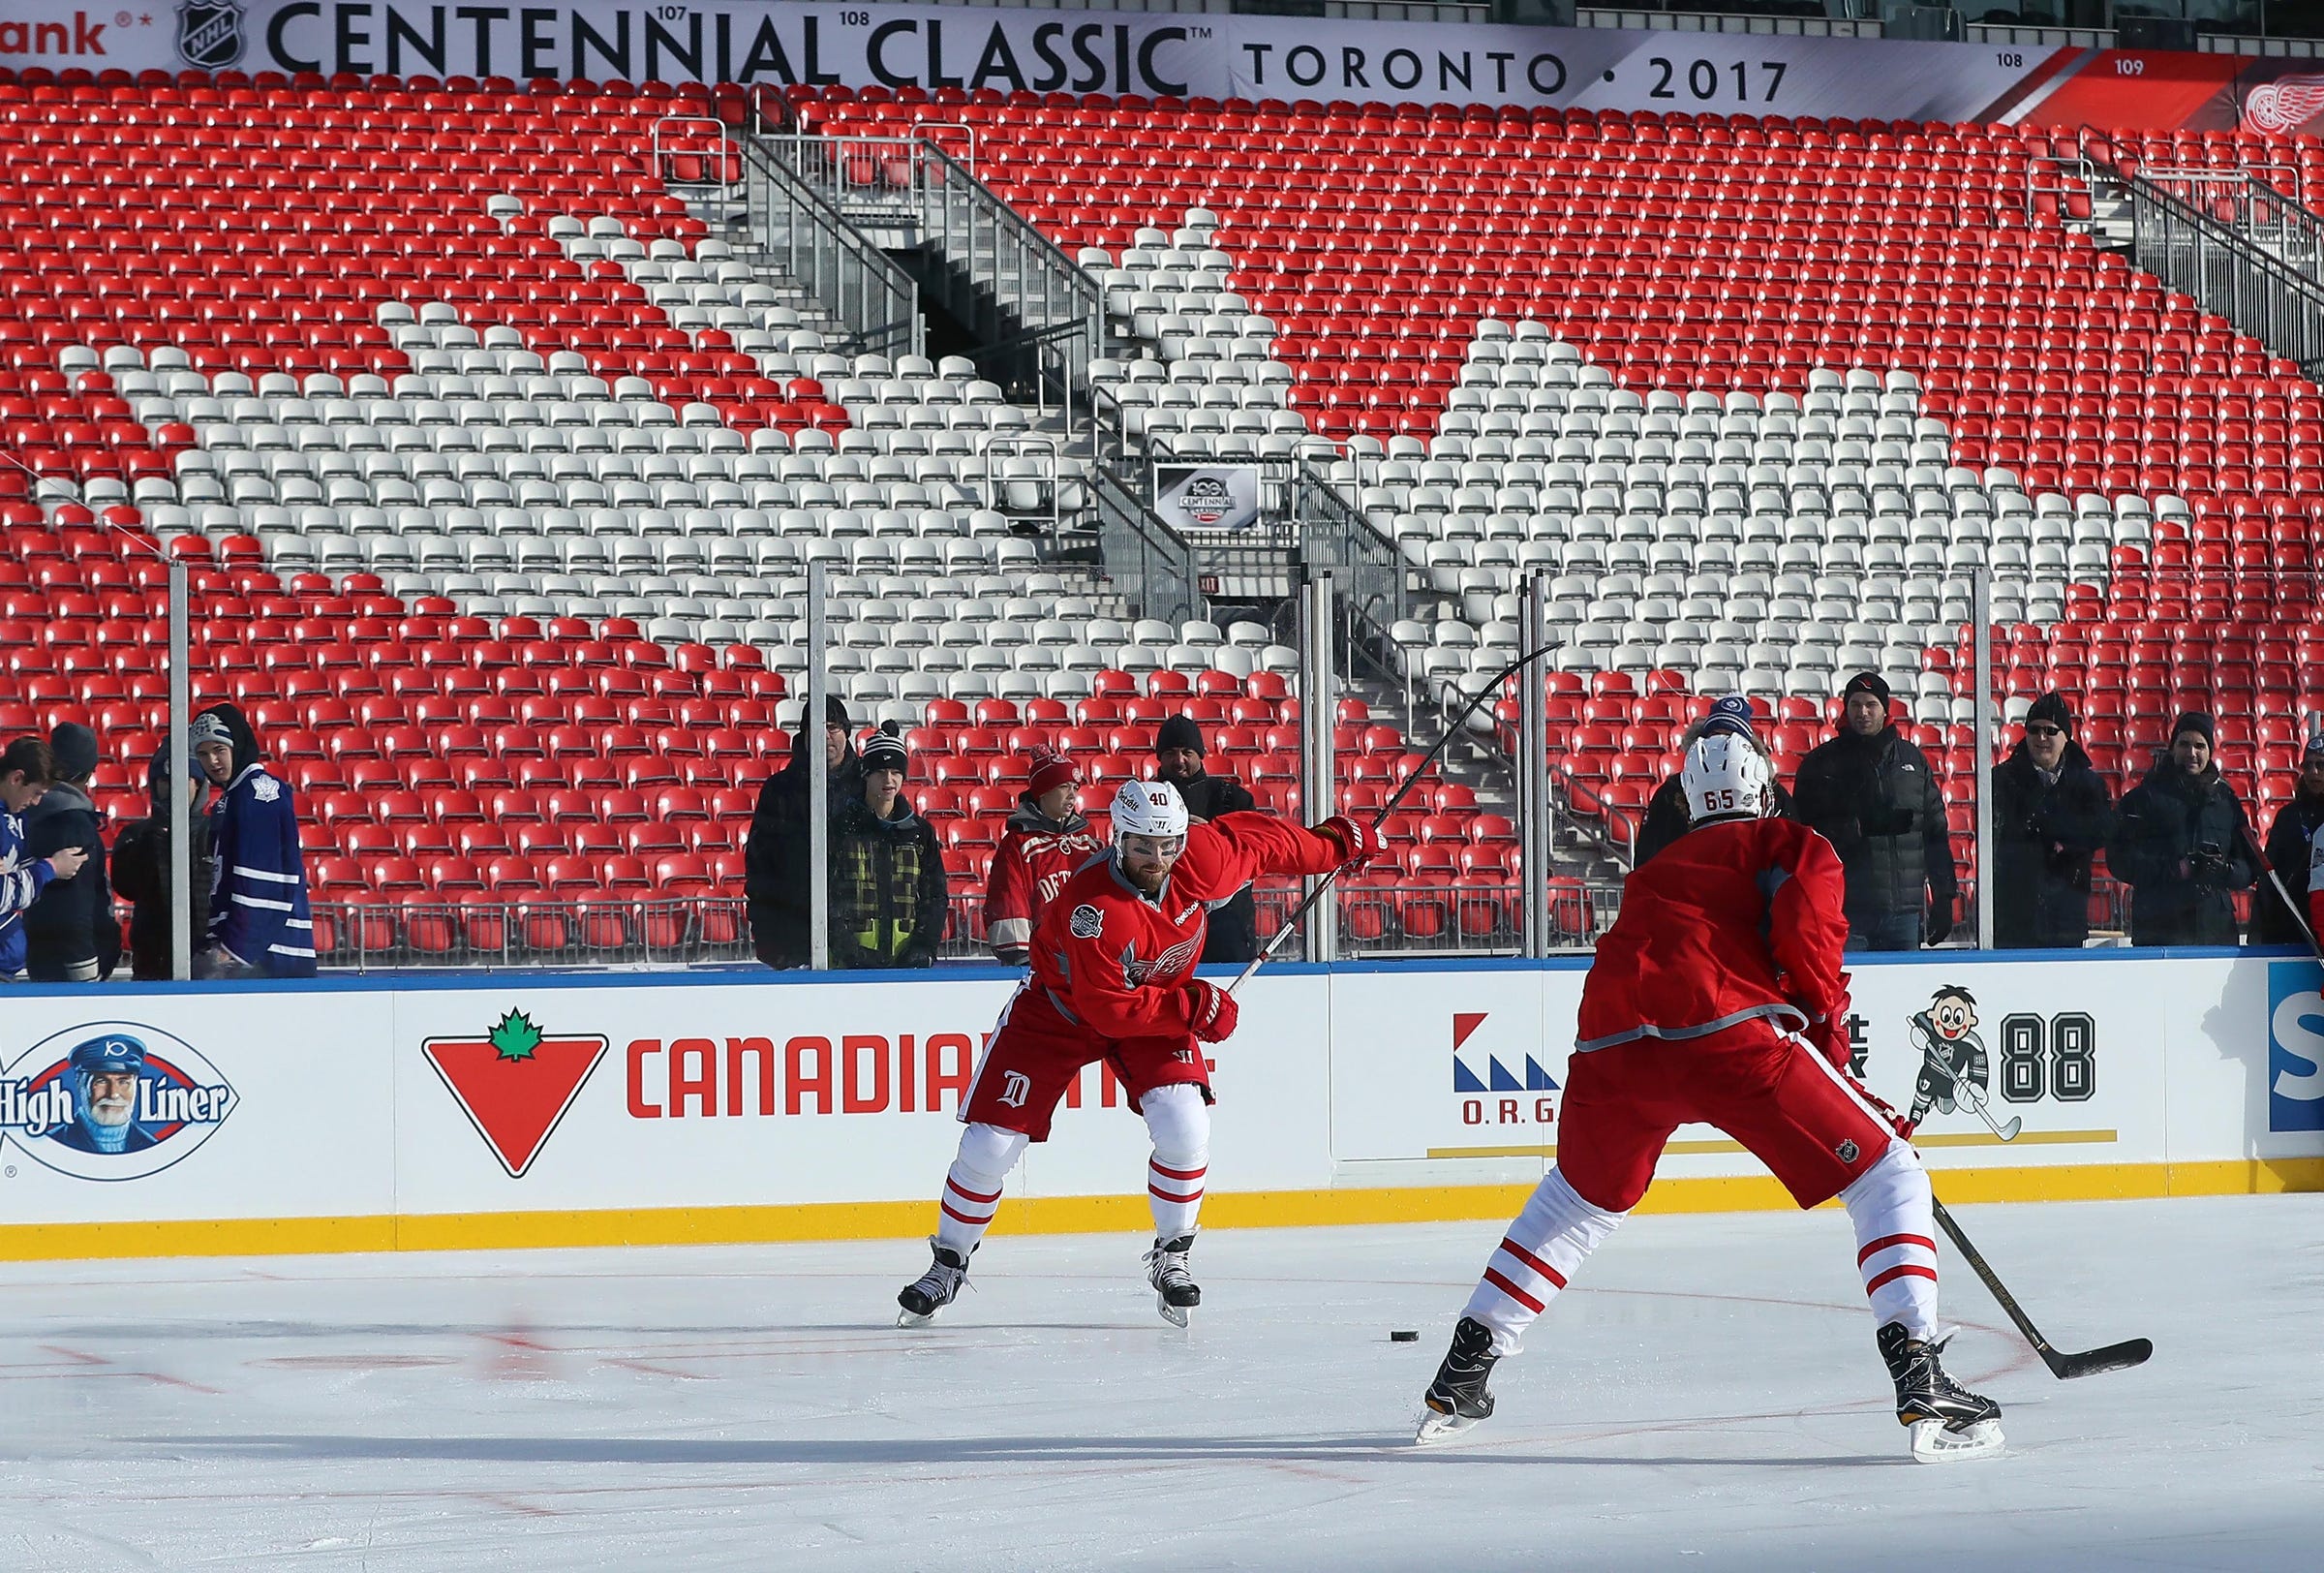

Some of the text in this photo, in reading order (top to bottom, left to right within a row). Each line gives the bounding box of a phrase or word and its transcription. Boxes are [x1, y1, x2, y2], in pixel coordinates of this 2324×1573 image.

[657, 6, 687, 21] 107
[839, 12, 870, 26] 108
[191, 17, 231, 55] NHL
[266, 2, 841, 85] CENTENNIAL
[1242, 43, 1788, 102] TORONTO 2017
[1995, 53, 2023, 68] 108
[2114, 58, 2144, 76] 109
[1200, 576, 1217, 592] XIT
[1149, 792, 1168, 806] 40
[1703, 788, 1734, 812] 65
[2000, 1012, 2096, 1103] 88
[627, 1033, 991, 1119] CANADIA
[0, 1076, 229, 1136] High Liner
